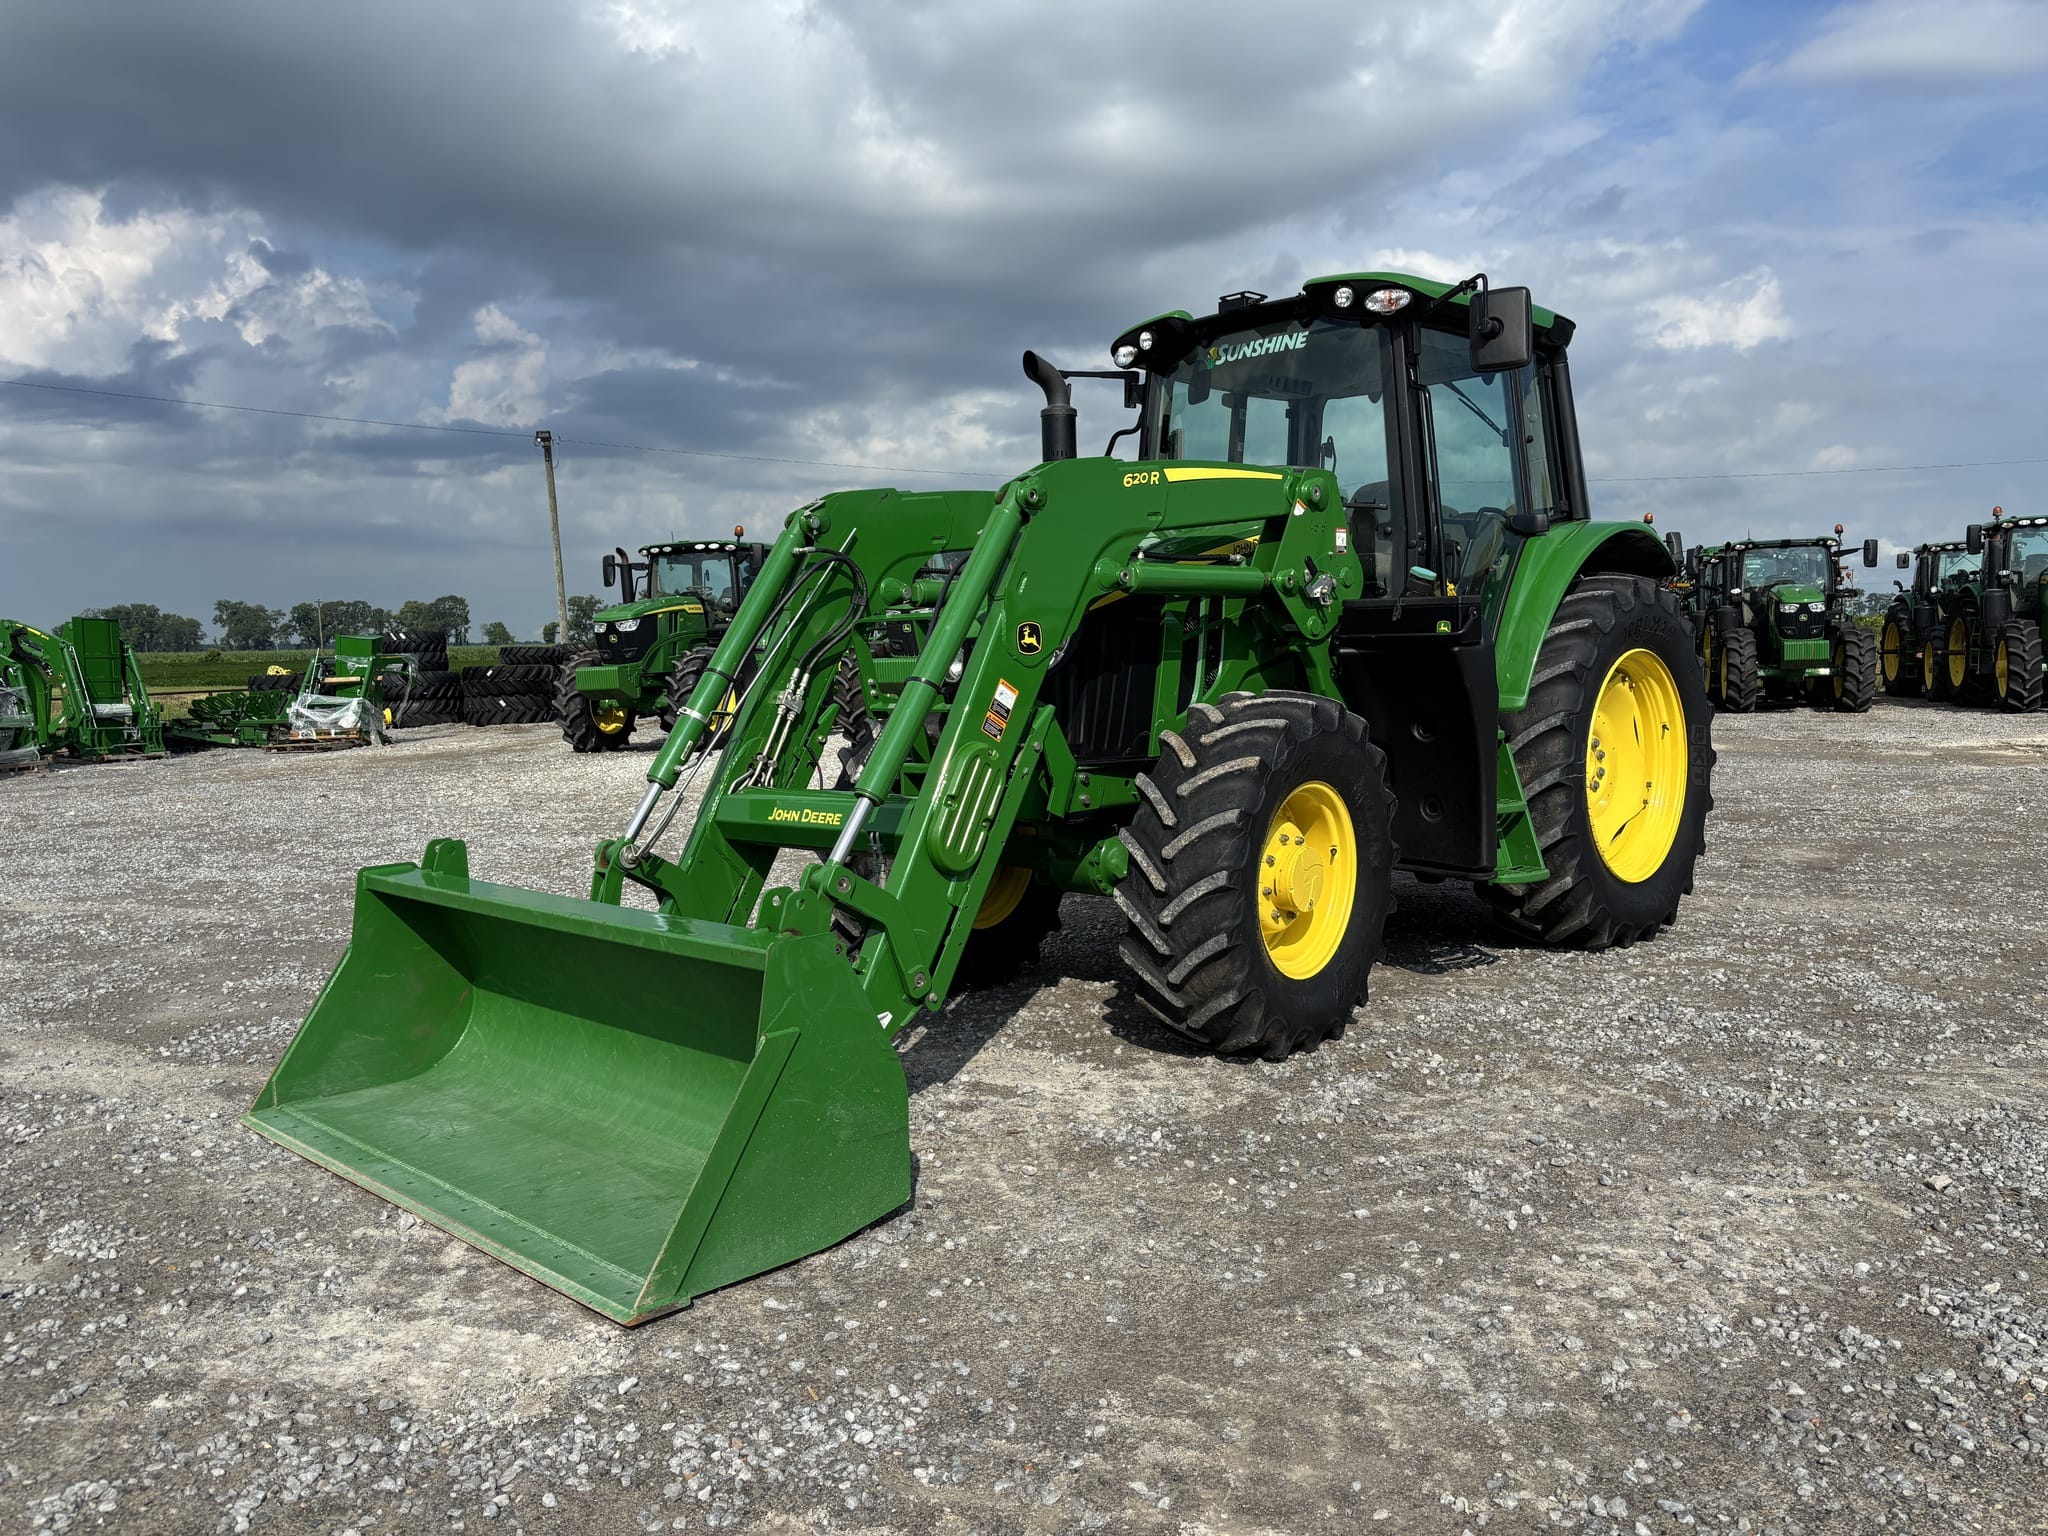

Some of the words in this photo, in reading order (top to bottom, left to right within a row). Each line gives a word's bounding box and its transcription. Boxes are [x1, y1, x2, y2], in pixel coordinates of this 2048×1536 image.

[1215, 331, 1309, 366] SUNSHINE
[1123, 472, 1149, 488] 620
[1150, 471, 1160, 485] R
[768, 807, 801, 822] JOHN
[801, 808, 842, 825] DEERE
